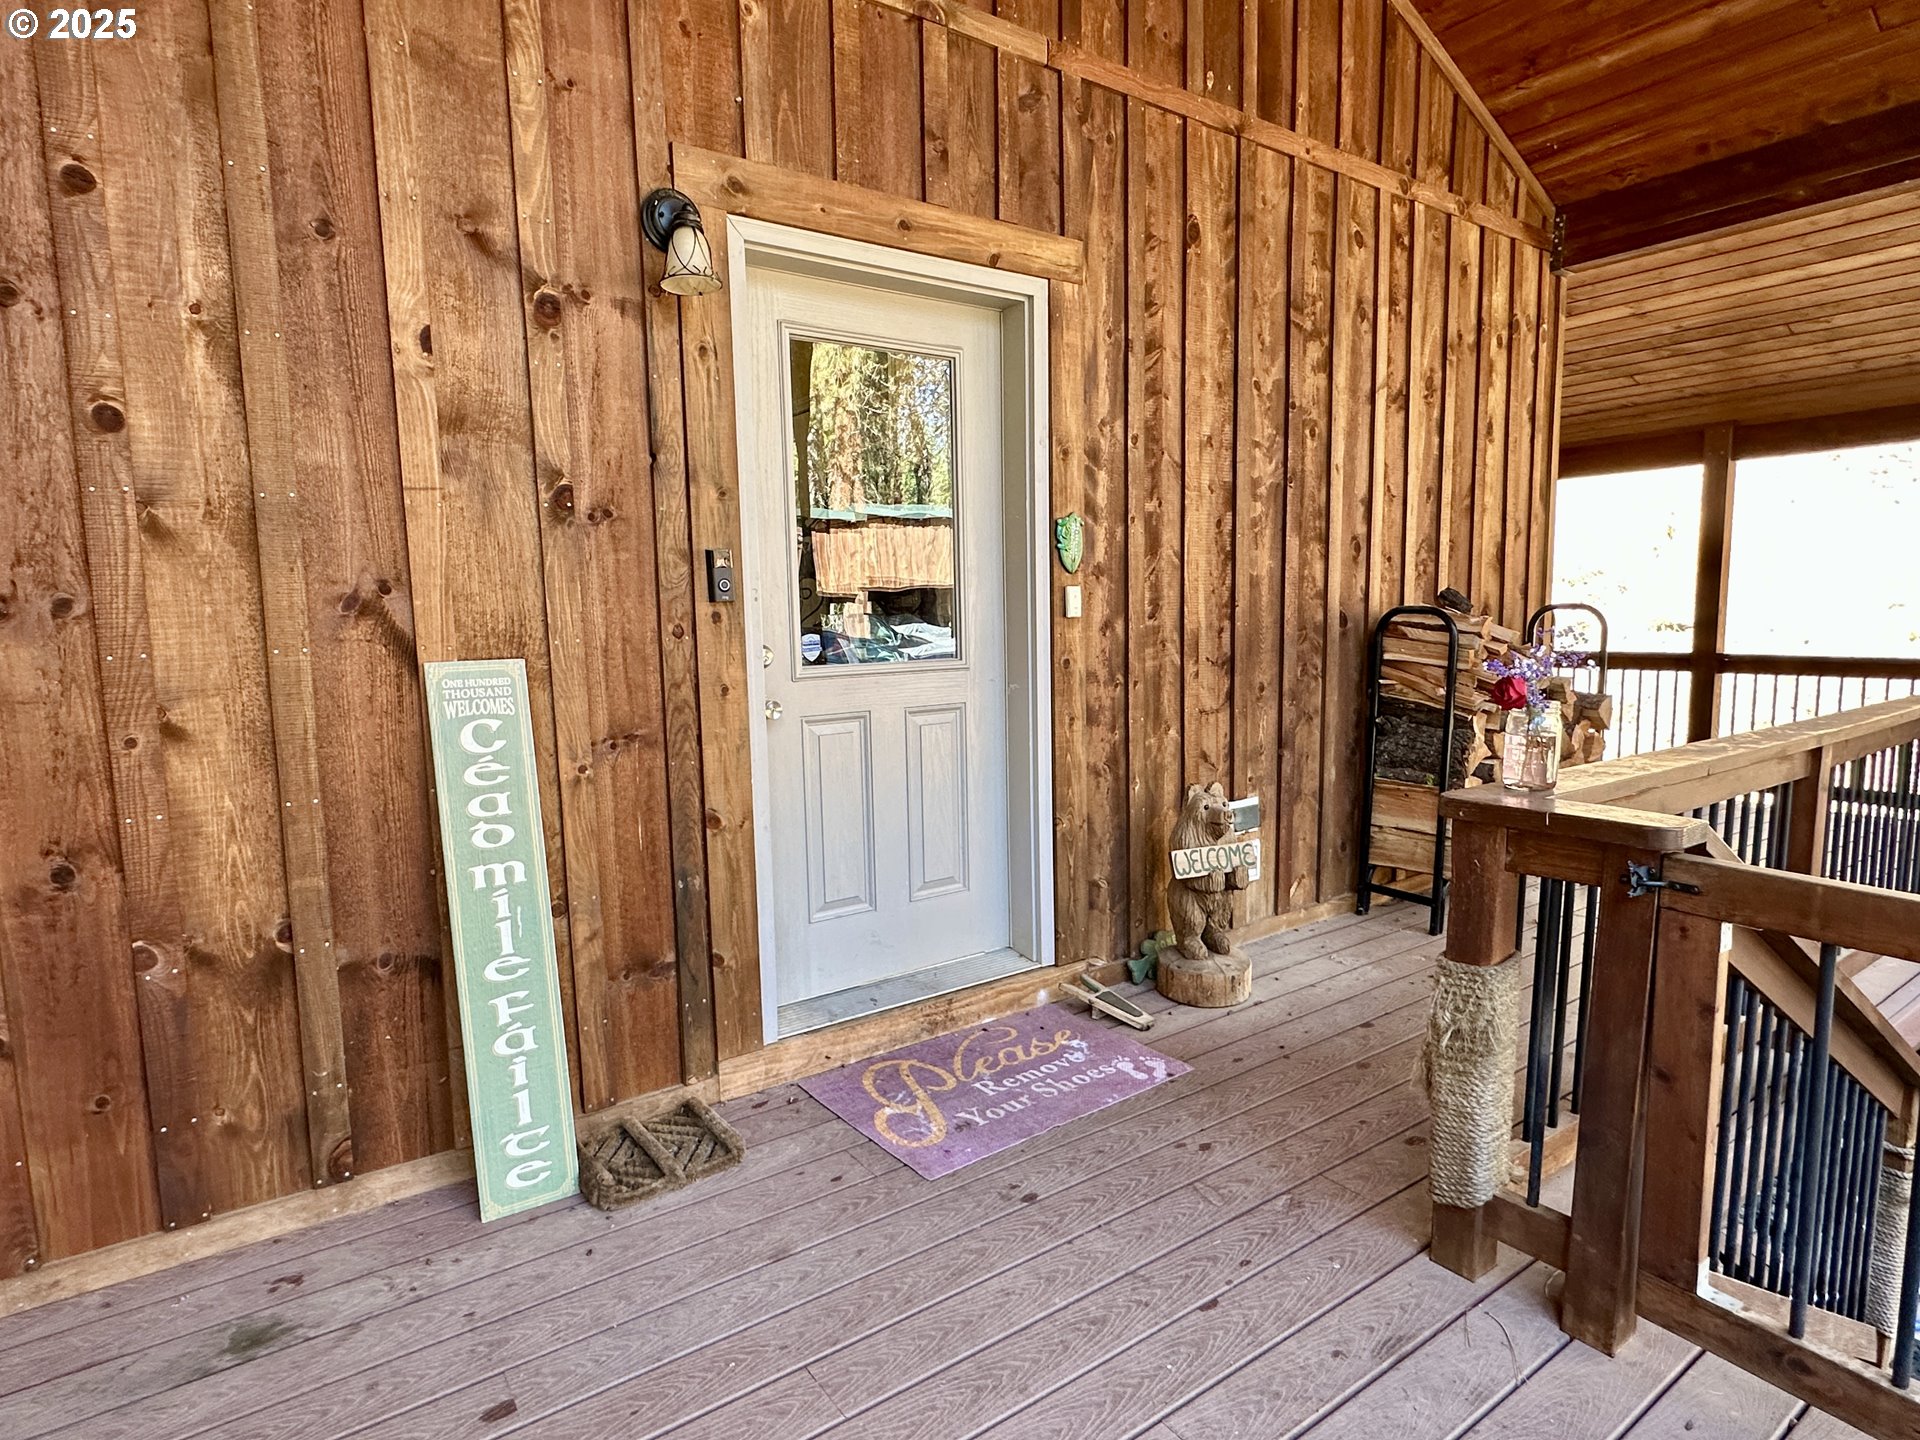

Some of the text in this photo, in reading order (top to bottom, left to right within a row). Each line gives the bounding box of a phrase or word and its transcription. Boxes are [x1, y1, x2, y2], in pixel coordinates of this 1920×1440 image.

[442, 686, 513, 700] THOUSAND
[465, 677, 511, 687] HUNDRED
[443, 697, 516, 720] WELCOMES
[1173, 843, 1257, 877] WELCOME
[861, 1027, 1073, 1148] Please
[954, 1063, 1118, 1126] Your Shoes
